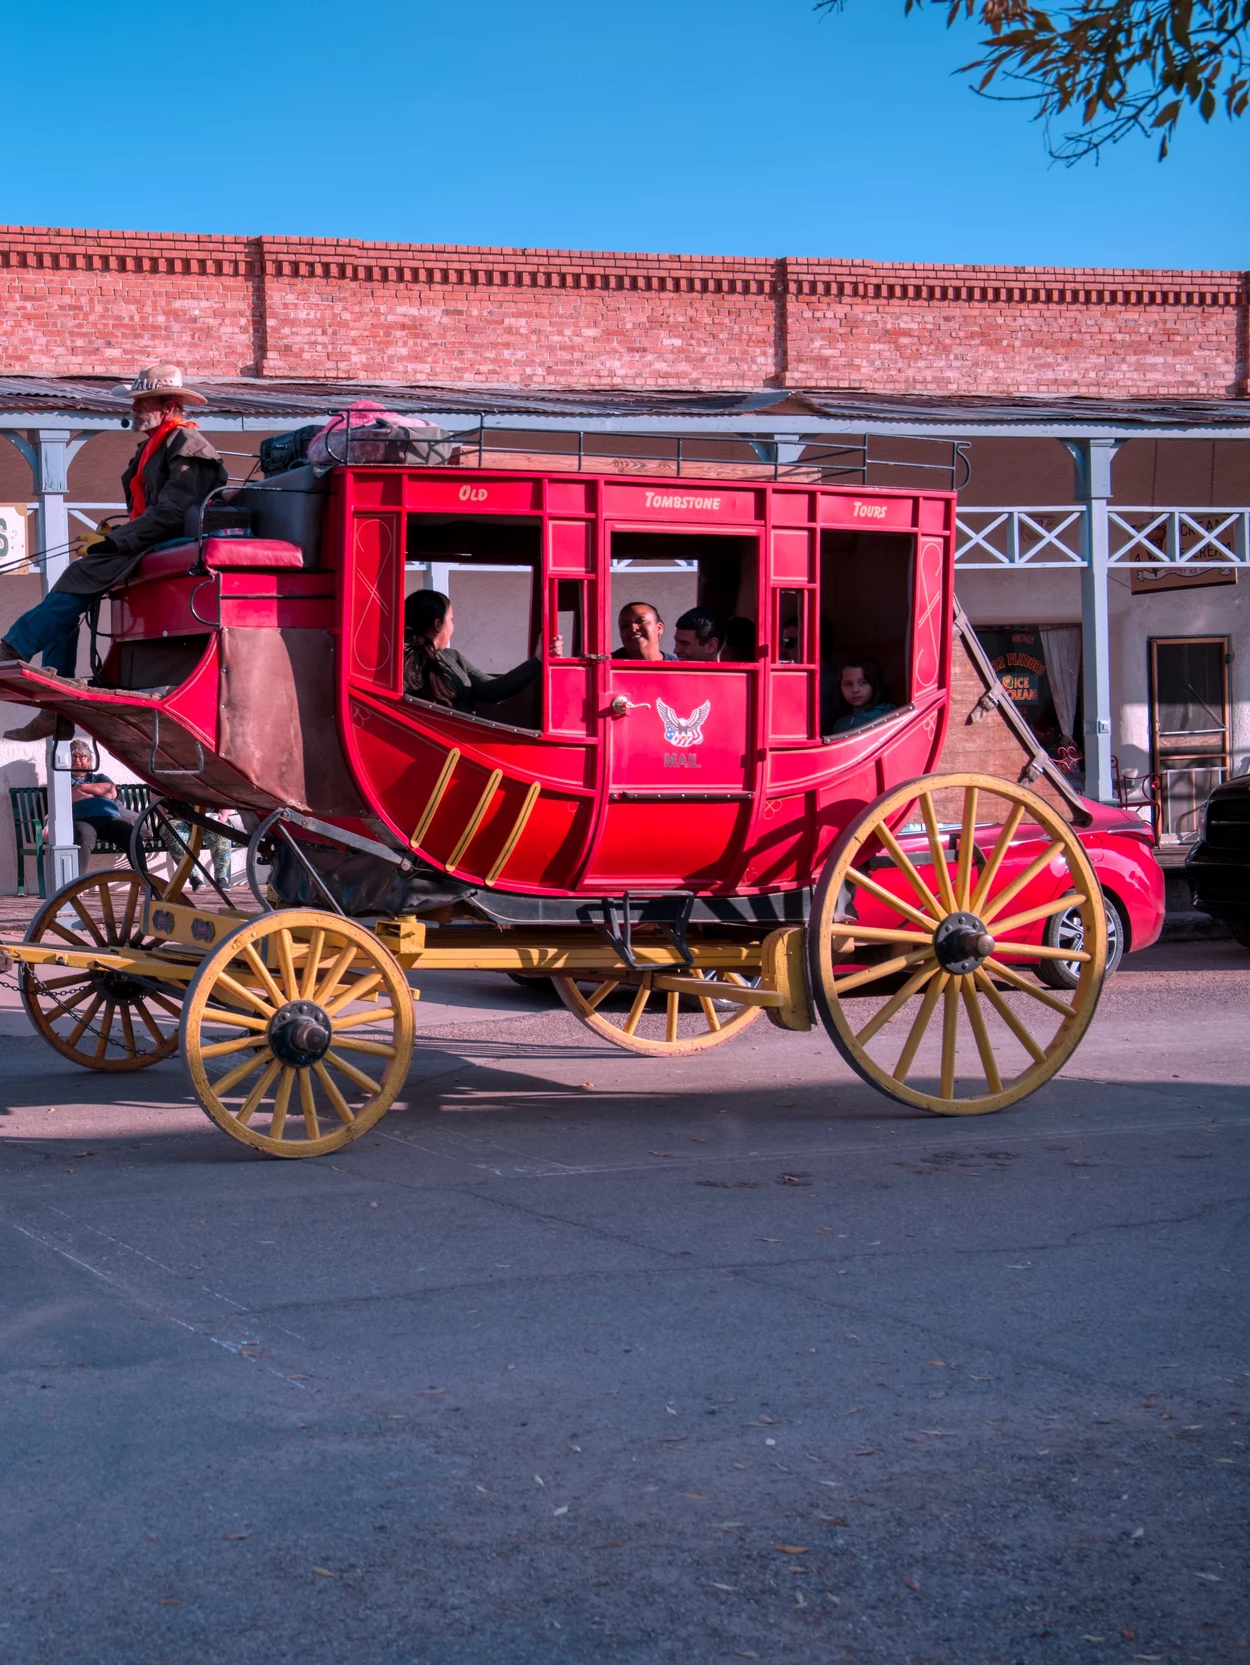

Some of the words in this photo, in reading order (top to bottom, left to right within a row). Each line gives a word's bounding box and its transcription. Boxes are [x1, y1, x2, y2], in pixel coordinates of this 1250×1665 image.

[458, 484, 489, 502] OLD
[644, 491, 722, 510] TOMBSTONE
[852, 501, 888, 519] TOURS
[1005, 652, 1047, 677] FLAVORS
[1013, 676, 1030, 689] ICE
[663, 752, 703, 769] MAIL
